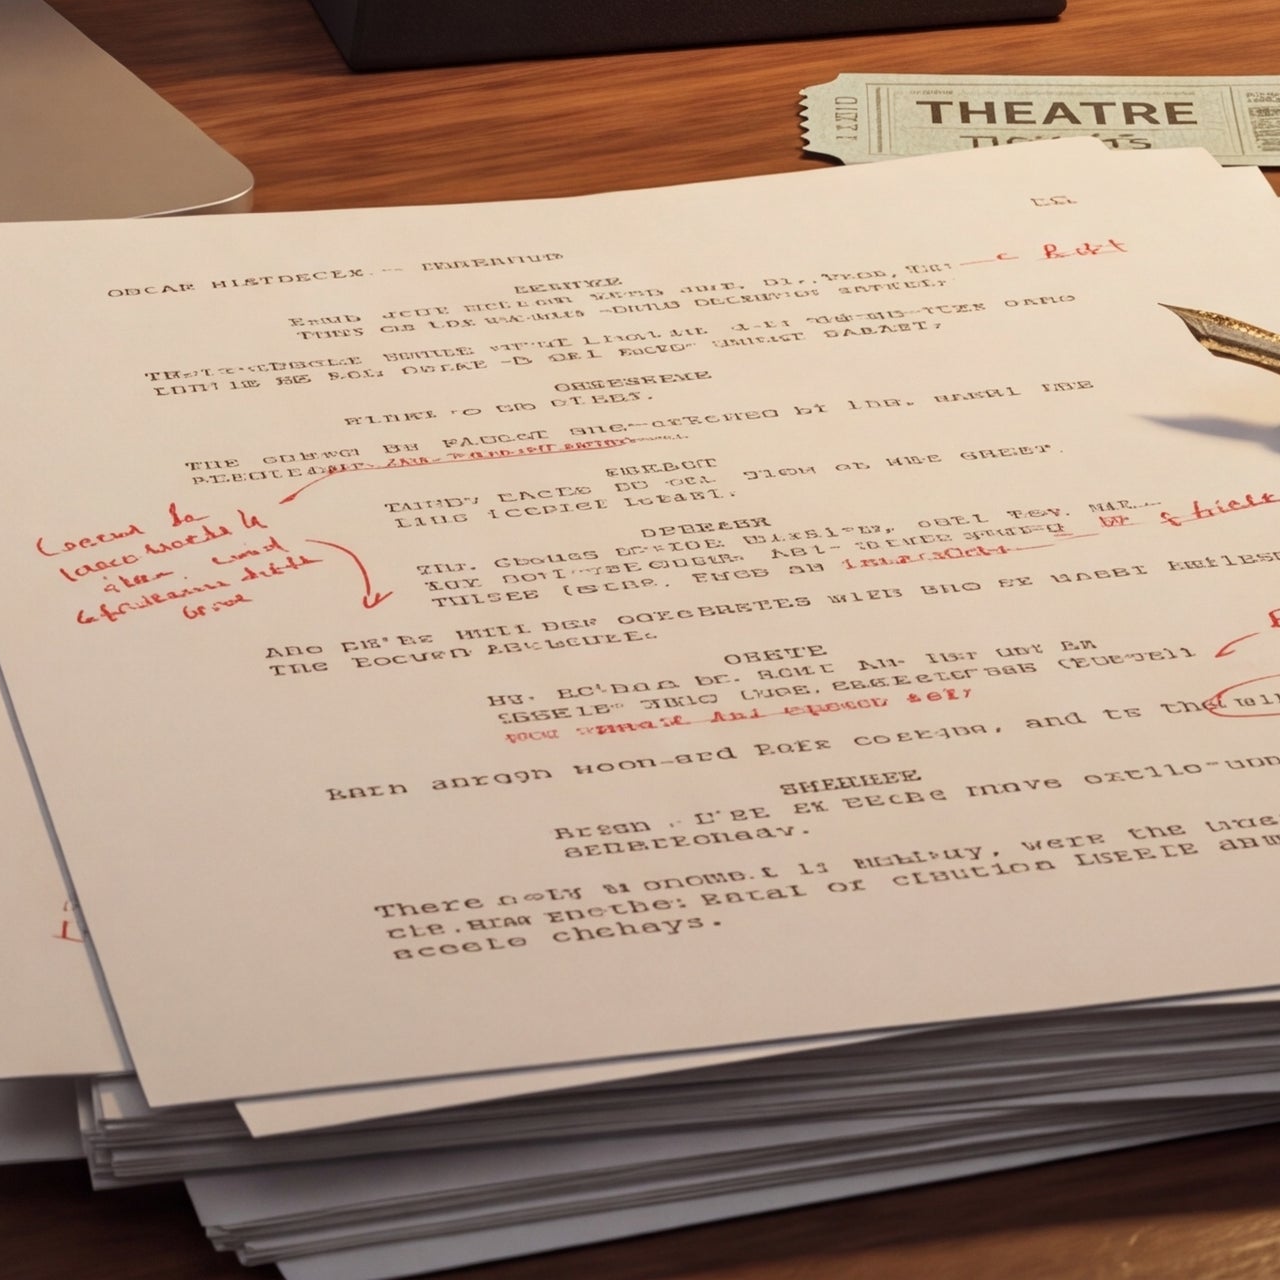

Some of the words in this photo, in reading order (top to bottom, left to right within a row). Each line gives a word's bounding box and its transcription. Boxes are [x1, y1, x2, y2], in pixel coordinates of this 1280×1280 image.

[916, 101, 1198, 125] THEATRE
[1026, 712, 1086, 730] and
[374, 897, 484, 918] There
[1128, 824, 1186, 841] the
